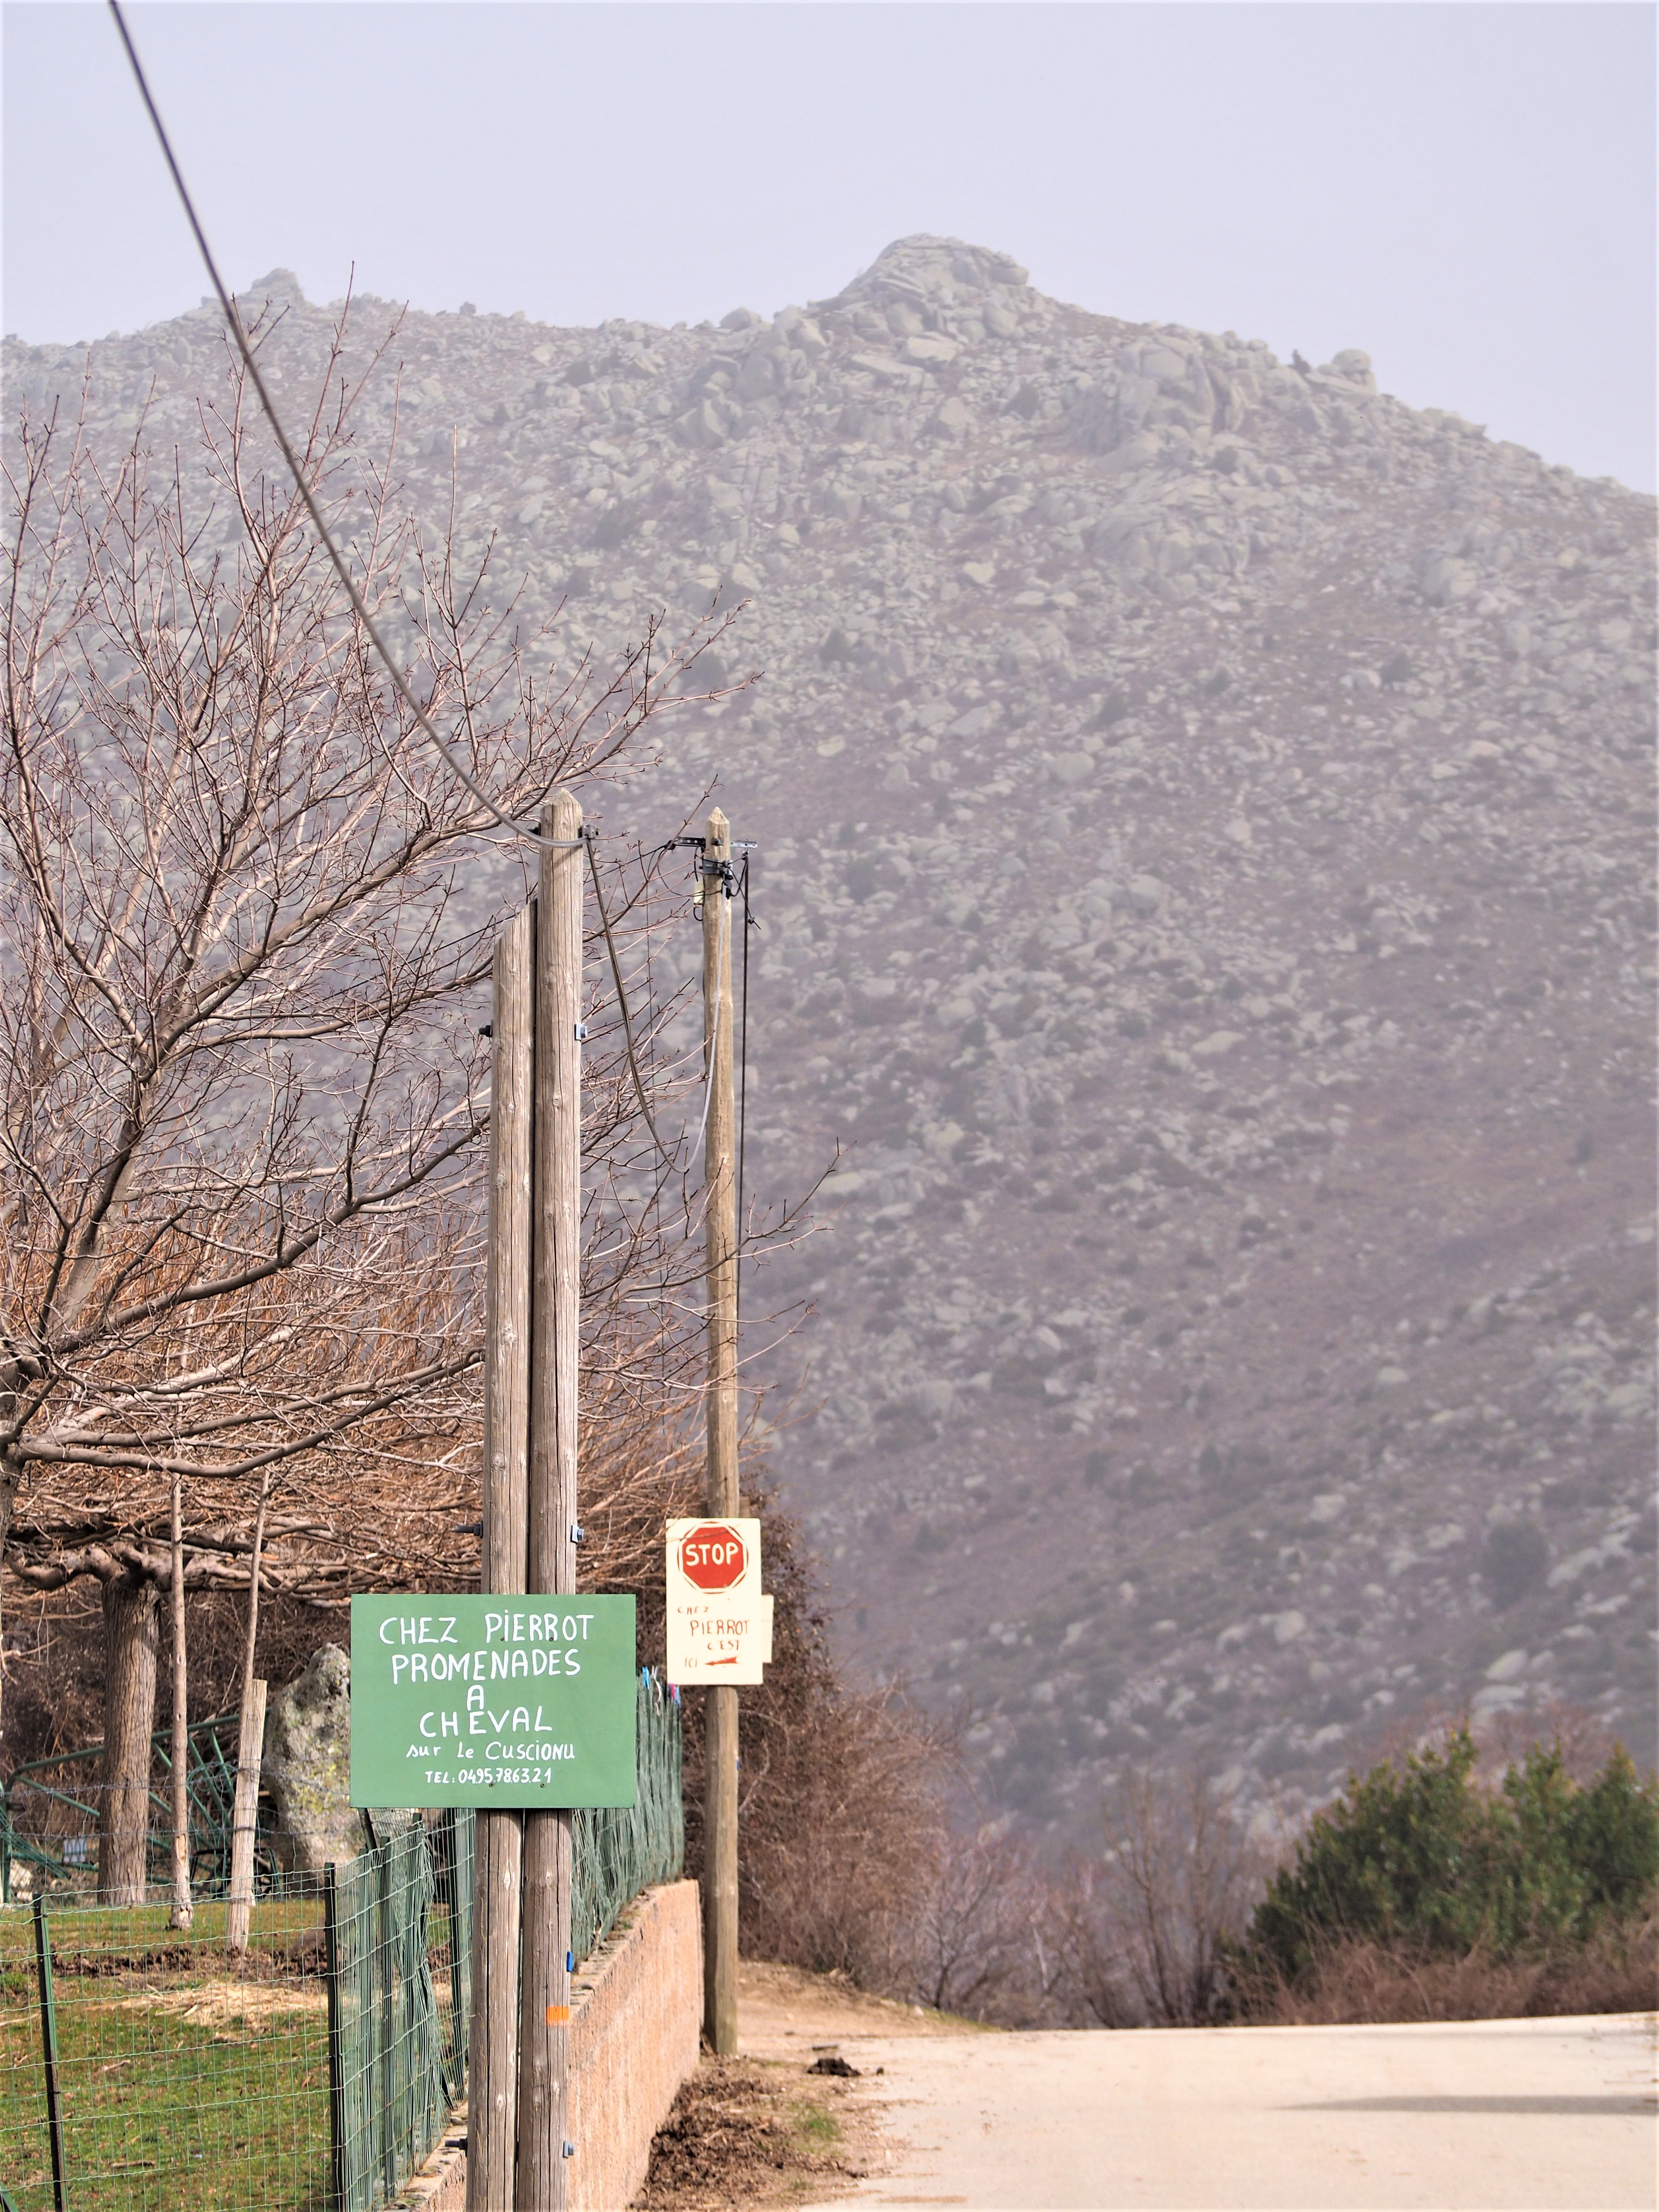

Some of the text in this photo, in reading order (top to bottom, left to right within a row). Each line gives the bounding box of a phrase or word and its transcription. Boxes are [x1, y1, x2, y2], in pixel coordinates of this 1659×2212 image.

[685, 1542, 738, 1566] STOP
[677, 1606, 709, 1615] CHEZ
[379, 1609, 594, 1645] CHEZ PIERROT
[690, 1619, 750, 1636] PIERROT
[392, 1648, 581, 1685] PROMENADES
[420, 1706, 553, 1738] CHEVAL
[406, 1744, 441, 1758] sur
